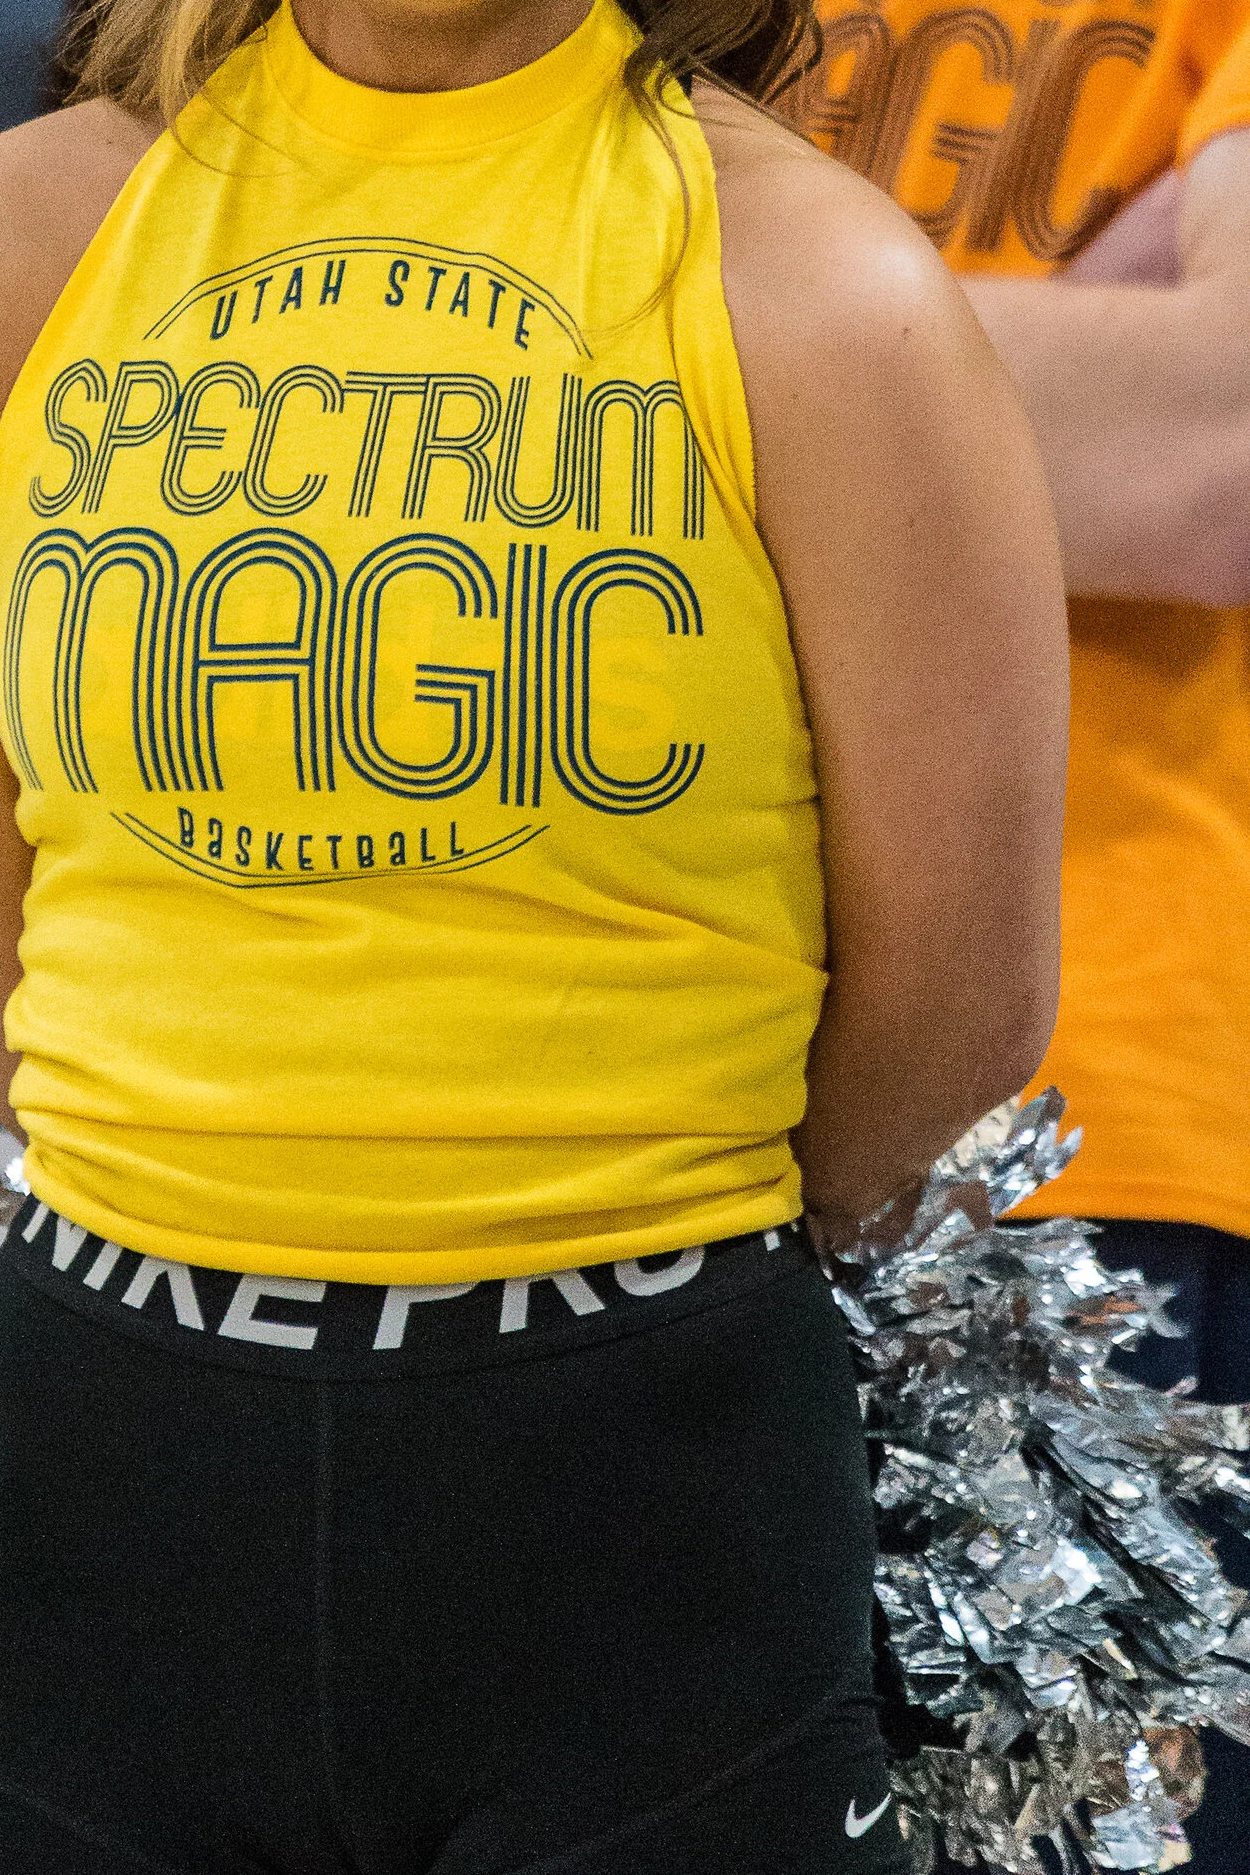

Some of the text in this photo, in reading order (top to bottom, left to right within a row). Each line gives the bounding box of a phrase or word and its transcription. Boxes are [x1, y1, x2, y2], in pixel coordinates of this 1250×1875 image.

[768, 7, 1156, 265] AGIC
[209, 257, 537, 351] UTAH STATE
[28, 357, 706, 541] SPECTRUM
[2, 527, 706, 815] MAGIC
